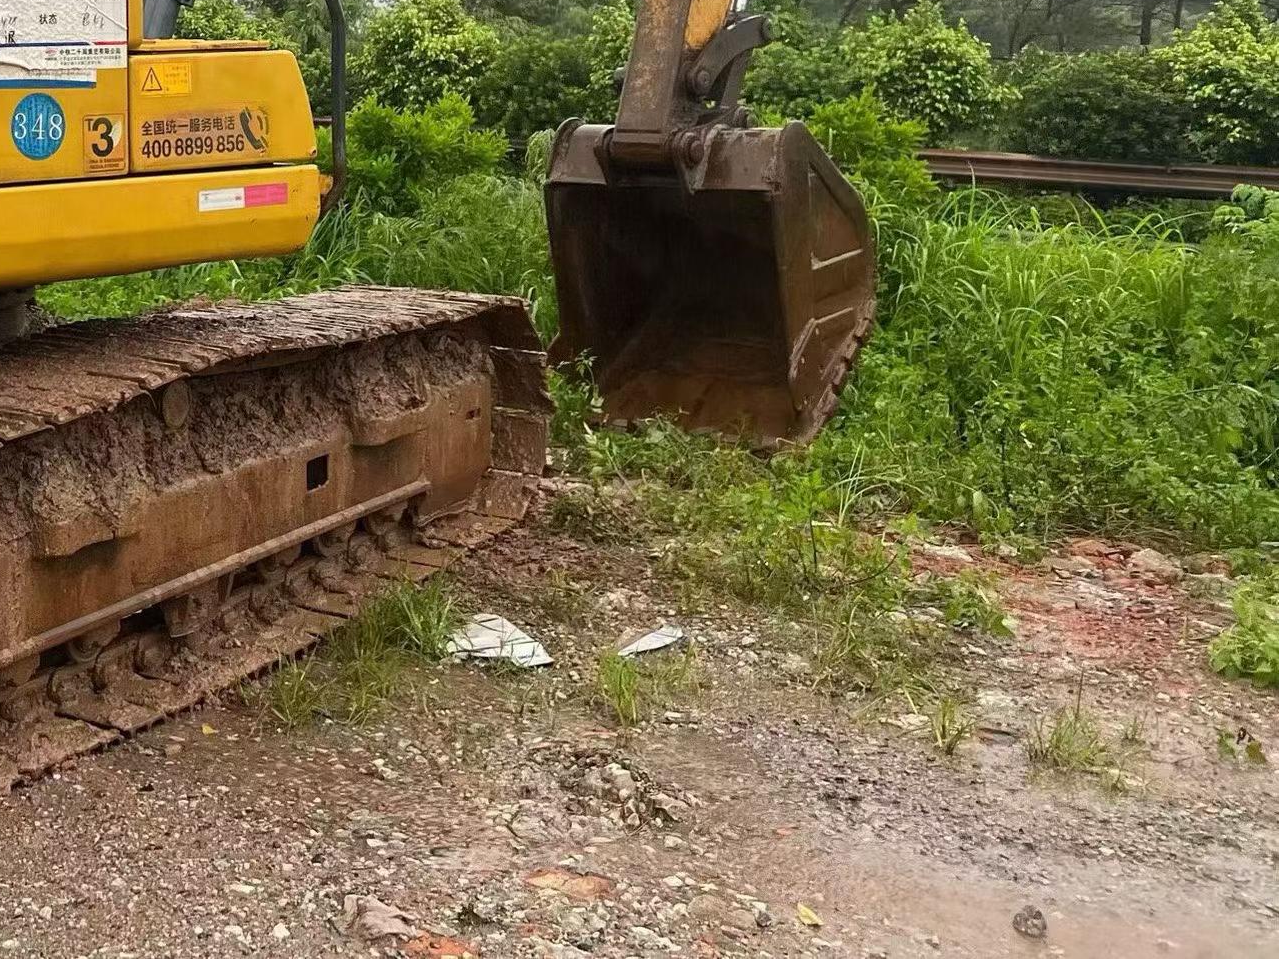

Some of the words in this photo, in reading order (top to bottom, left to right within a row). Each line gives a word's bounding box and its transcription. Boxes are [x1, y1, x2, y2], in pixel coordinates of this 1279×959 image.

[38, 13, 58, 25] 状态
[14, 112, 63, 140] 348
[141, 116, 236, 137] 全国统一服务电话
[142, 139, 171, 159] 400
[174, 136, 213, 157] 8899
[216, 133, 245, 153] 856
